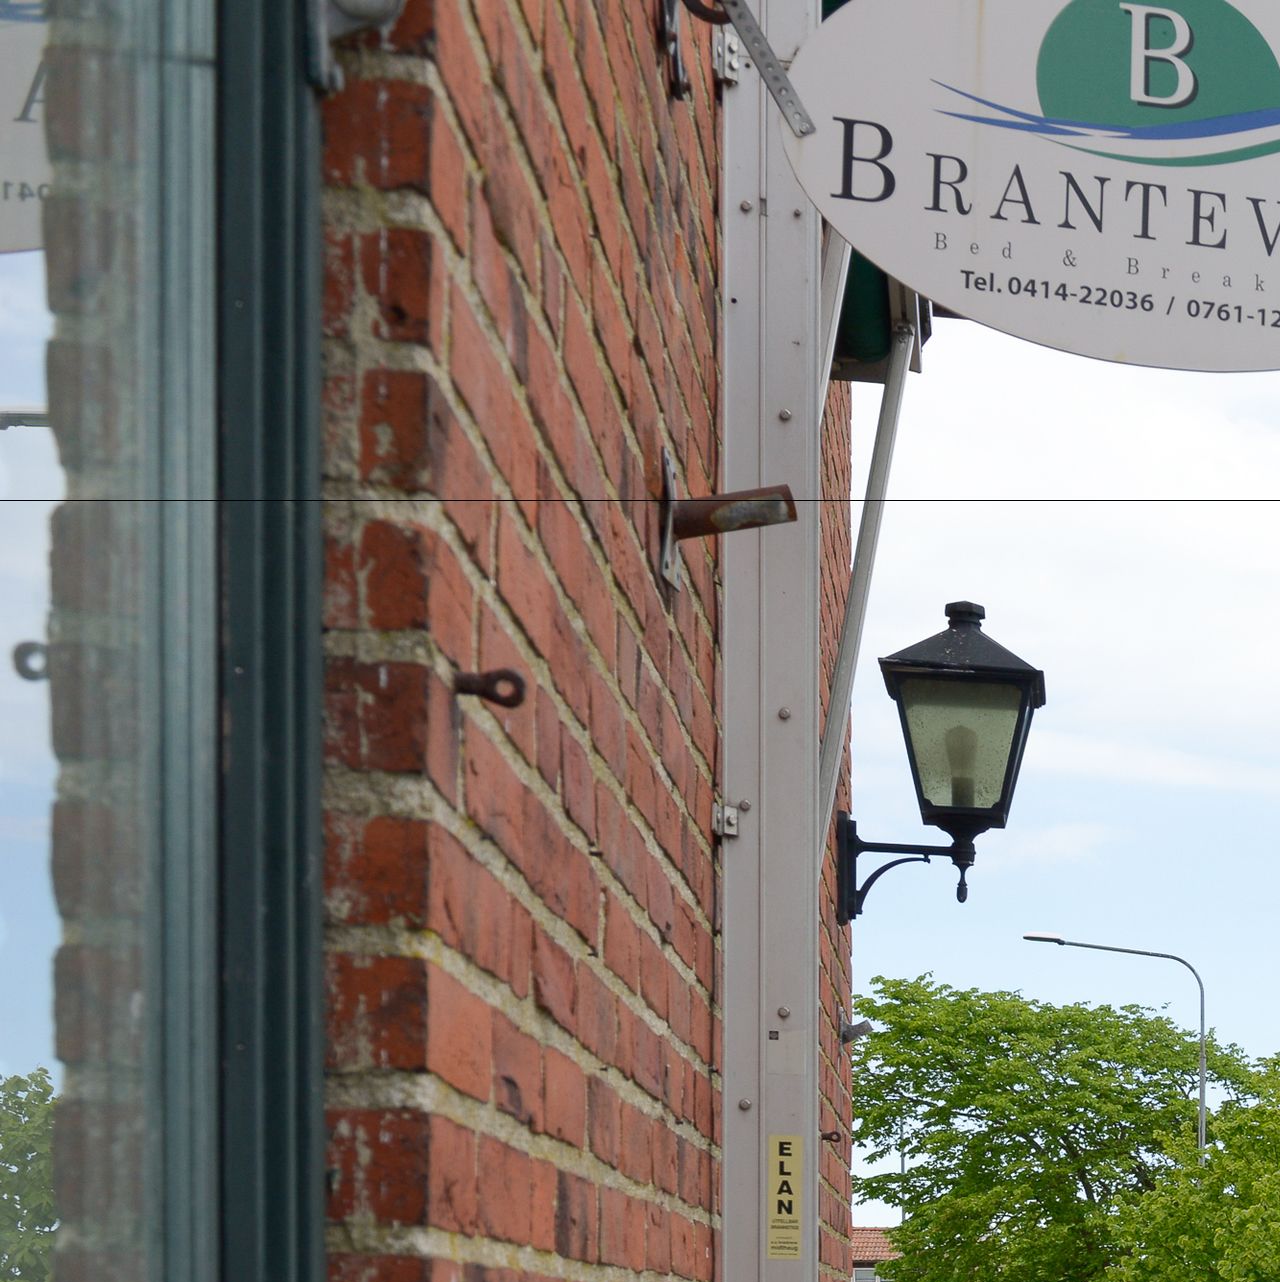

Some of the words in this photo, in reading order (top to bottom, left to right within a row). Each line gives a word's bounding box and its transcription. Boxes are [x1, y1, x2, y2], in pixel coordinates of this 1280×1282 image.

[1118, 2, 1197, 108] B
[934, 232, 1013, 262] Bed
[1062, 248, 1078, 268] &
[960, 269, 1003, 294] Tel.
[1008, 276, 1155, 313] 0414-22036
[1166, 296, 1176, 316] /
[777, 1141, 794, 1215] ELAN
